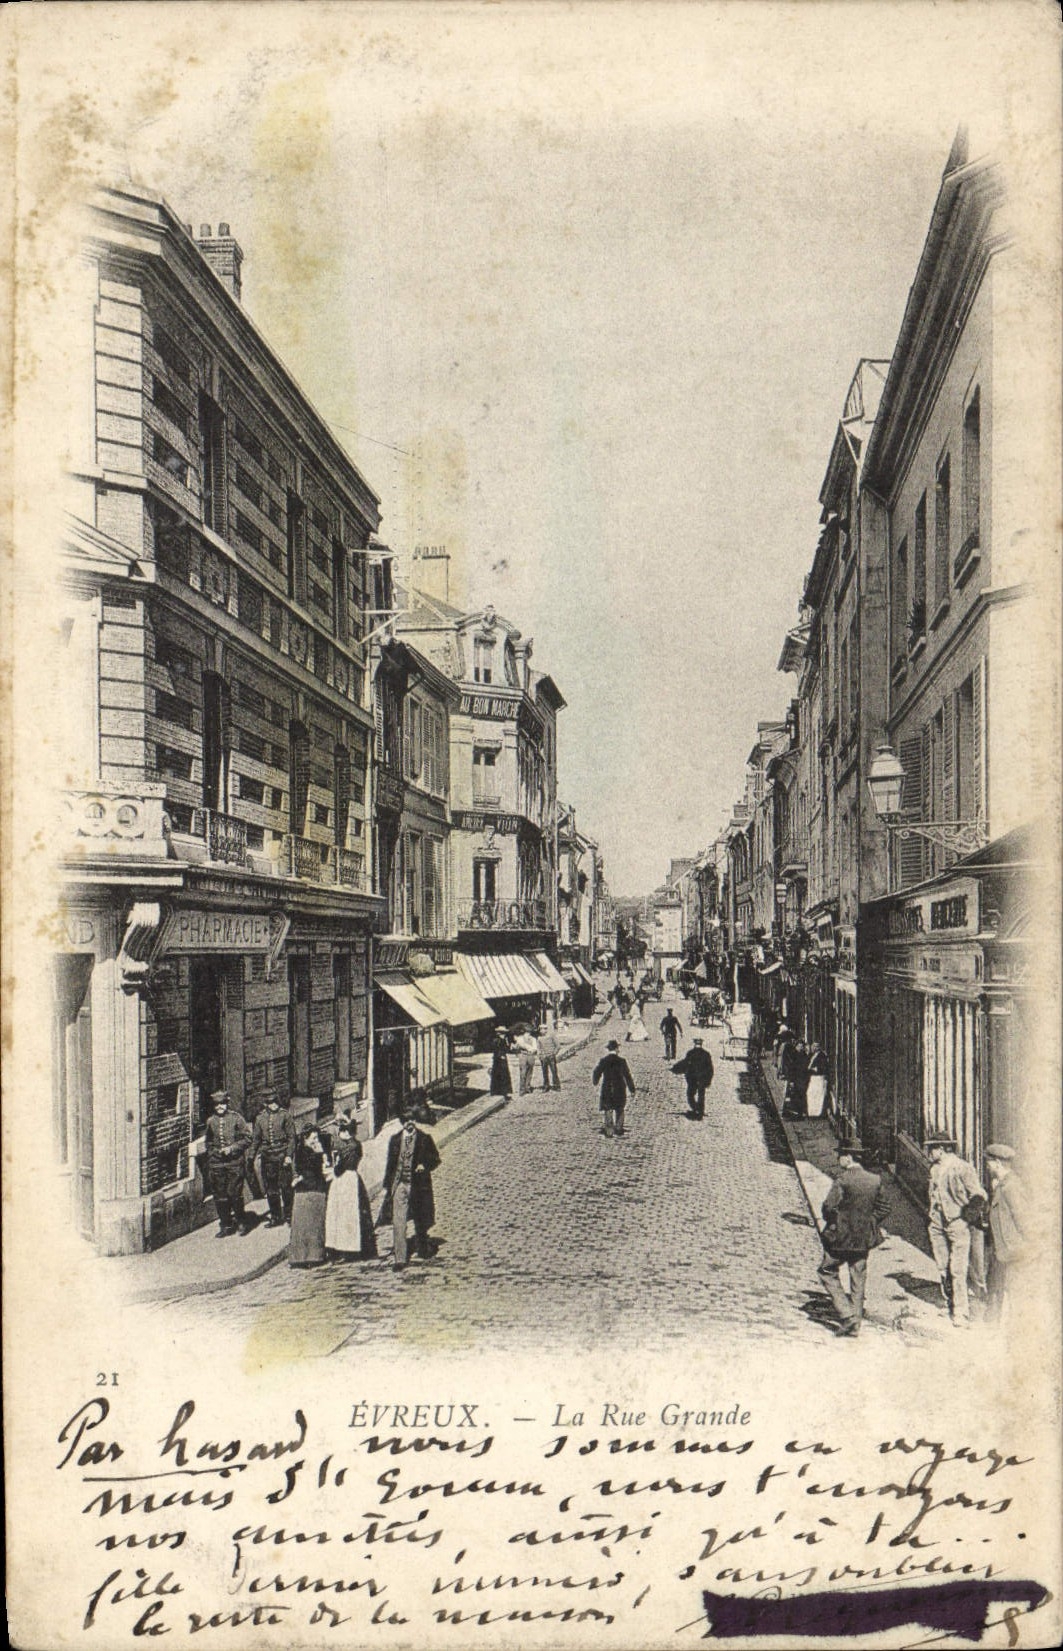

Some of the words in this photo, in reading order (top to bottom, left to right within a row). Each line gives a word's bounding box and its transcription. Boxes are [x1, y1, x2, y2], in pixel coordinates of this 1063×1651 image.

[459, 695, 471, 713] AU
[473, 697, 490, 715] BON
[179, 915, 262, 945] PHARMACIE
[56, 1397, 125, 1470] Par
[360, 1435, 494, 1459] nous
[544, 1435, 754, 1459] sommes
[784, 1440, 840, 1456] en
[878, 1437, 1034, 1490] voyage
[594, 1477, 728, 1498] nous
[95, 1530, 187, 1551] nos
[132, 1600, 172, 1637] le
[188, 1605, 291, 1634] reste
[309, 1601, 351, 1628] de
[370, 1601, 410, 1625] la
